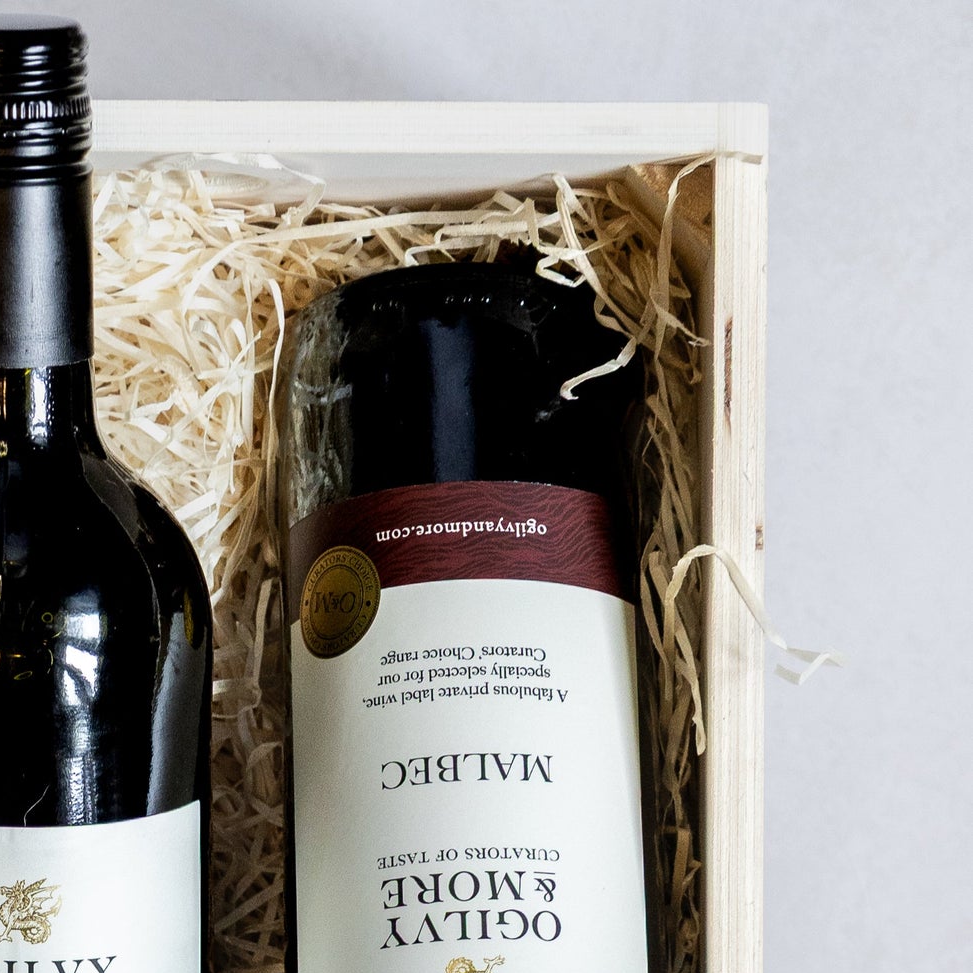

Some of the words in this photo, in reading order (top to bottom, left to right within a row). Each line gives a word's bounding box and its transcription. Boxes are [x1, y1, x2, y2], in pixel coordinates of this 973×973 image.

[377, 517, 547, 541] ogilvyandmore.com
[381, 651, 418, 665] range
[423, 647, 475, 661] Choice
[479, 647, 546, 661] Curators'
[404, 670, 424, 683] for
[428, 666, 486, 682] selected
[491, 662, 550, 679] specially
[378, 674, 400, 686] our
[401, 689, 434, 705] label
[438, 682, 489, 698] private
[493, 686, 553, 701] fabulous
[557, 690, 568, 702] A
[363, 694, 397, 708] wine,
[382, 753, 552, 790] MALBEC
[377, 852, 429, 869] TASTE
[436, 849, 458, 861] OF
[465, 847, 559, 861] CURATORS
[381, 871, 526, 909] MORE
[534, 878, 556, 902] &
[380, 909, 561, 949] OGILVY
